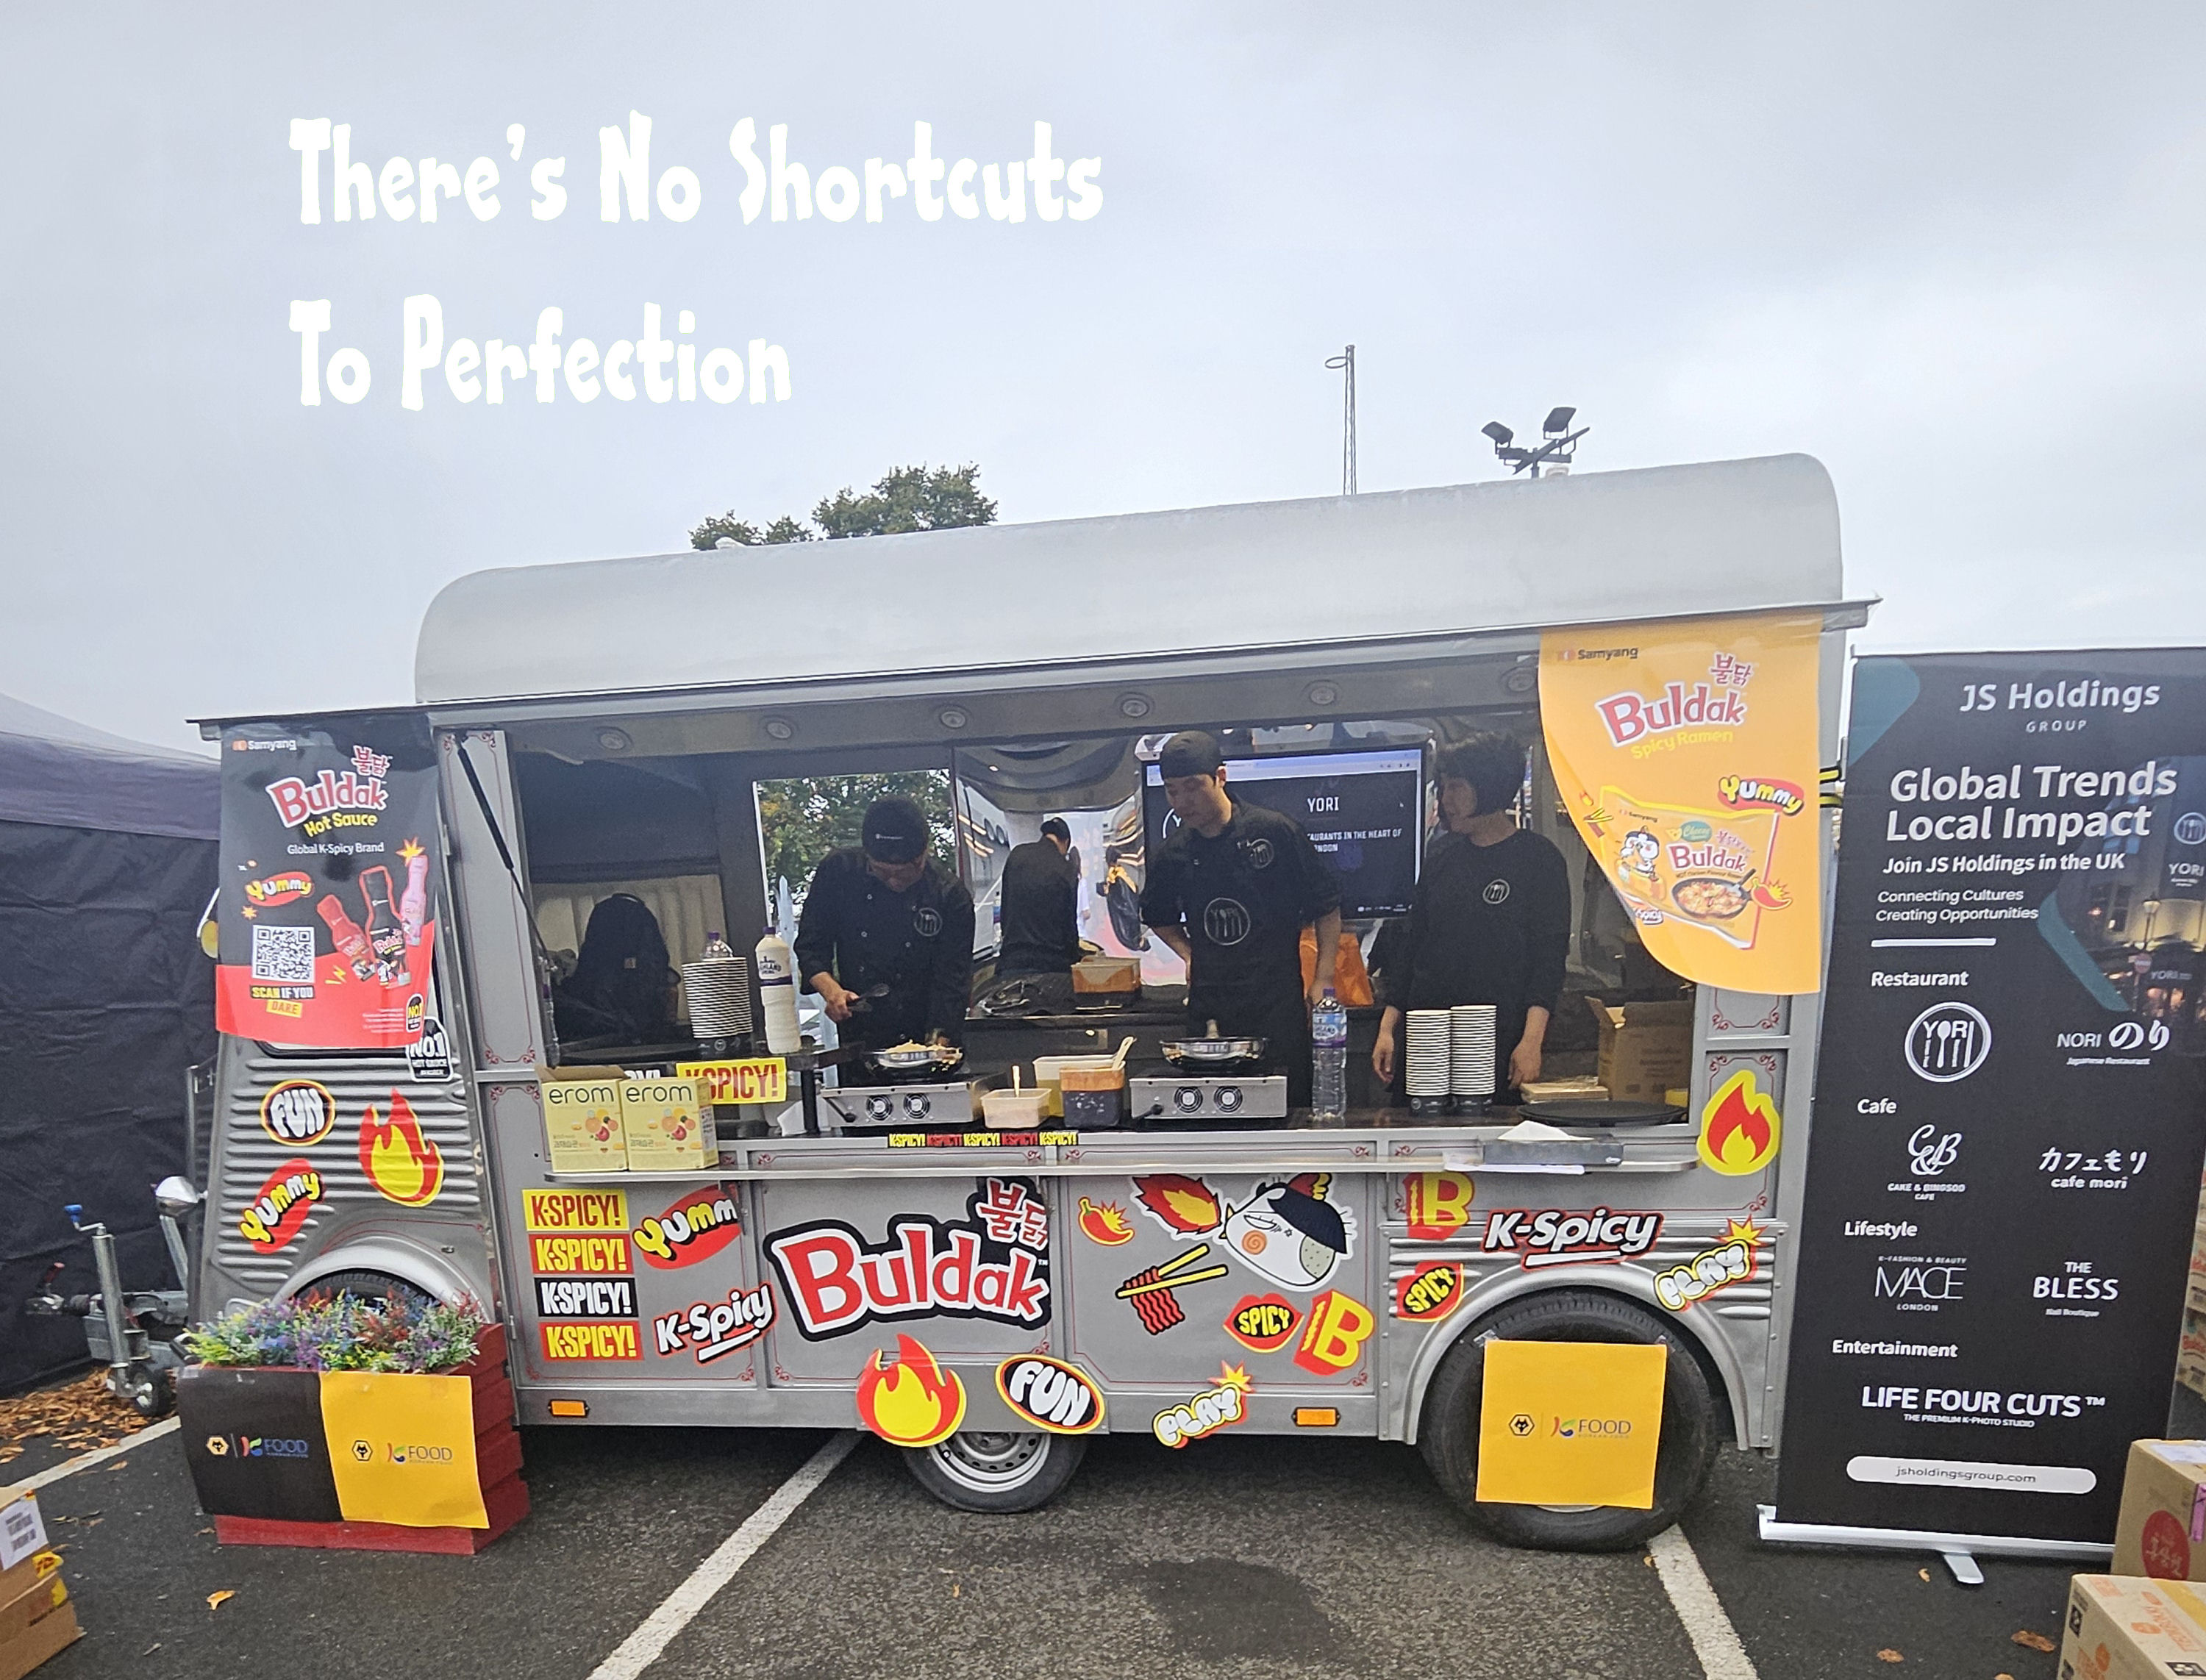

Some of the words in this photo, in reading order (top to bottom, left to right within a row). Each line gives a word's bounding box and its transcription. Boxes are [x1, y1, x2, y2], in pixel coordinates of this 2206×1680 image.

[1577, 647, 1638, 660] Samyang
[1711, 653, 1753, 686] 불닭
[1960, 684, 1997, 712] JS
[2008, 679, 2160, 713] Holdings
[1596, 683, 1746, 746] Buldak
[2026, 720, 2087, 733] GROUP
[248, 740, 297, 751] Samyang
[1630, 737, 1676, 759] Spicy
[1677, 730, 1734, 745] Ramen
[351, 745, 390, 778] 불닭
[1890, 764, 2021, 802] Global
[2033, 760, 2177, 798] Trends
[266, 771, 388, 828] Buldak
[1307, 796, 1340, 812] YORI
[1718, 776, 1804, 814] Yummy
[304, 816, 332, 837] Hot
[332, 812, 378, 828] Sauce
[1887, 806, 1993, 841] Local
[2002, 805, 2152, 846] Impact
[288, 843, 318, 854] Global
[355, 842, 385, 853] Brand
[1668, 844, 1746, 872] Buldak
[1882, 856, 1921, 873] Join
[1925, 856, 1949, 873] JS
[1952, 854, 2035, 875] Holdings
[2038, 854, 2057, 871] in
[2060, 854, 2091, 871] the
[2096, 852, 2127, 870] UK
[246, 879, 312, 901] Yummy
[1877, 889, 1960, 905] Connecting
[1962, 888, 2024, 901] Cultures
[1875, 908, 1937, 924] Creating
[1939, 907, 2040, 923] Opportunities
[1871, 971, 1969, 987] Restaurant
[251, 987, 280, 998] SCAN
[282, 987, 292, 998] IF
[293, 987, 314, 998] YOU
[271, 1001, 299, 1015] DARE
[2057, 1033, 2102, 1048] NORI
[2108, 1019, 2170, 1051] のり
[549, 1086, 614, 1104] erom
[627, 1084, 692, 1103] erom
[1857, 1098, 1897, 1115] Cafe
[271, 1088, 326, 1137] FUN
[2051, 1176, 2085, 1189] cafe
[2089, 1176, 2130, 1190] mori
[240, 1171, 321, 1244] Yummy
[632, 1199, 738, 1259] Yumm
[1485, 1209, 1661, 1253] K-Spicy
[1845, 1221, 1918, 1240] Lifestyle
[774, 1226, 1046, 1329] Buldak
[1658, 1244, 1745, 1308] PLAY
[2064, 1261, 2093, 1273] THE
[1406, 1267, 1455, 1312] SPICY
[1874, 1266, 1967, 1300] MACE
[2033, 1276, 2118, 1301] BLESS
[656, 1284, 774, 1355] K-Spicy
[1238, 1305, 1290, 1335] SPICY
[1896, 1304, 1938, 1312] LONDON
[1313, 1290, 1374, 1367] B
[1832, 1340, 1958, 1358] Entertainment
[1010, 1361, 1090, 1427] FUN
[1862, 1386, 1919, 1409] LIFE
[1924, 1389, 2001, 1414] FOUR
[1159, 1387, 1237, 1443] PLAY
[1579, 1419, 1632, 1434] FOOD
[1904, 1413, 1920, 1422] THE
[2002, 1418, 2035, 1428] STUDIO
[264, 1439, 309, 1454] FOOD
[409, 1445, 453, 1461] FOOD
[1895, 1465, 2036, 1484] jsholdingsgroup.com
